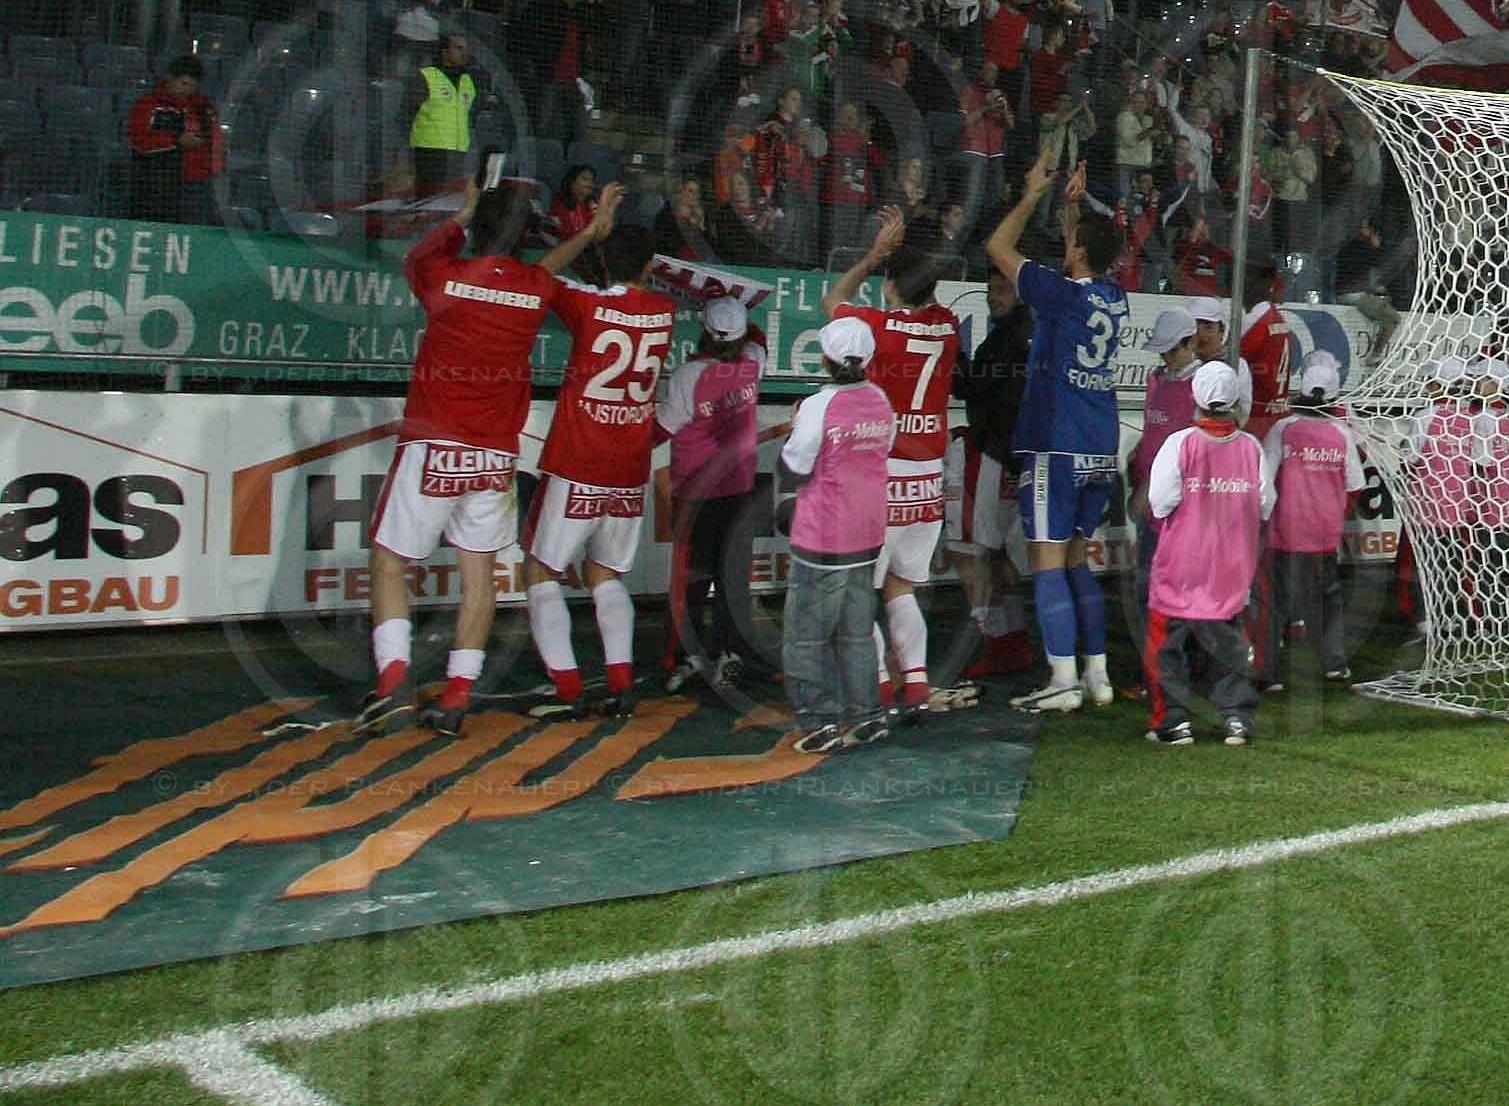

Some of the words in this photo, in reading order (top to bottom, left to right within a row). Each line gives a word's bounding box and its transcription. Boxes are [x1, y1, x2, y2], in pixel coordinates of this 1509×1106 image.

[444, 280, 541, 310] LIEBHERR
[219, 320, 309, 357] GRAZ
[583, 329, 669, 403] 25
[906, 339, 944, 411] 7
